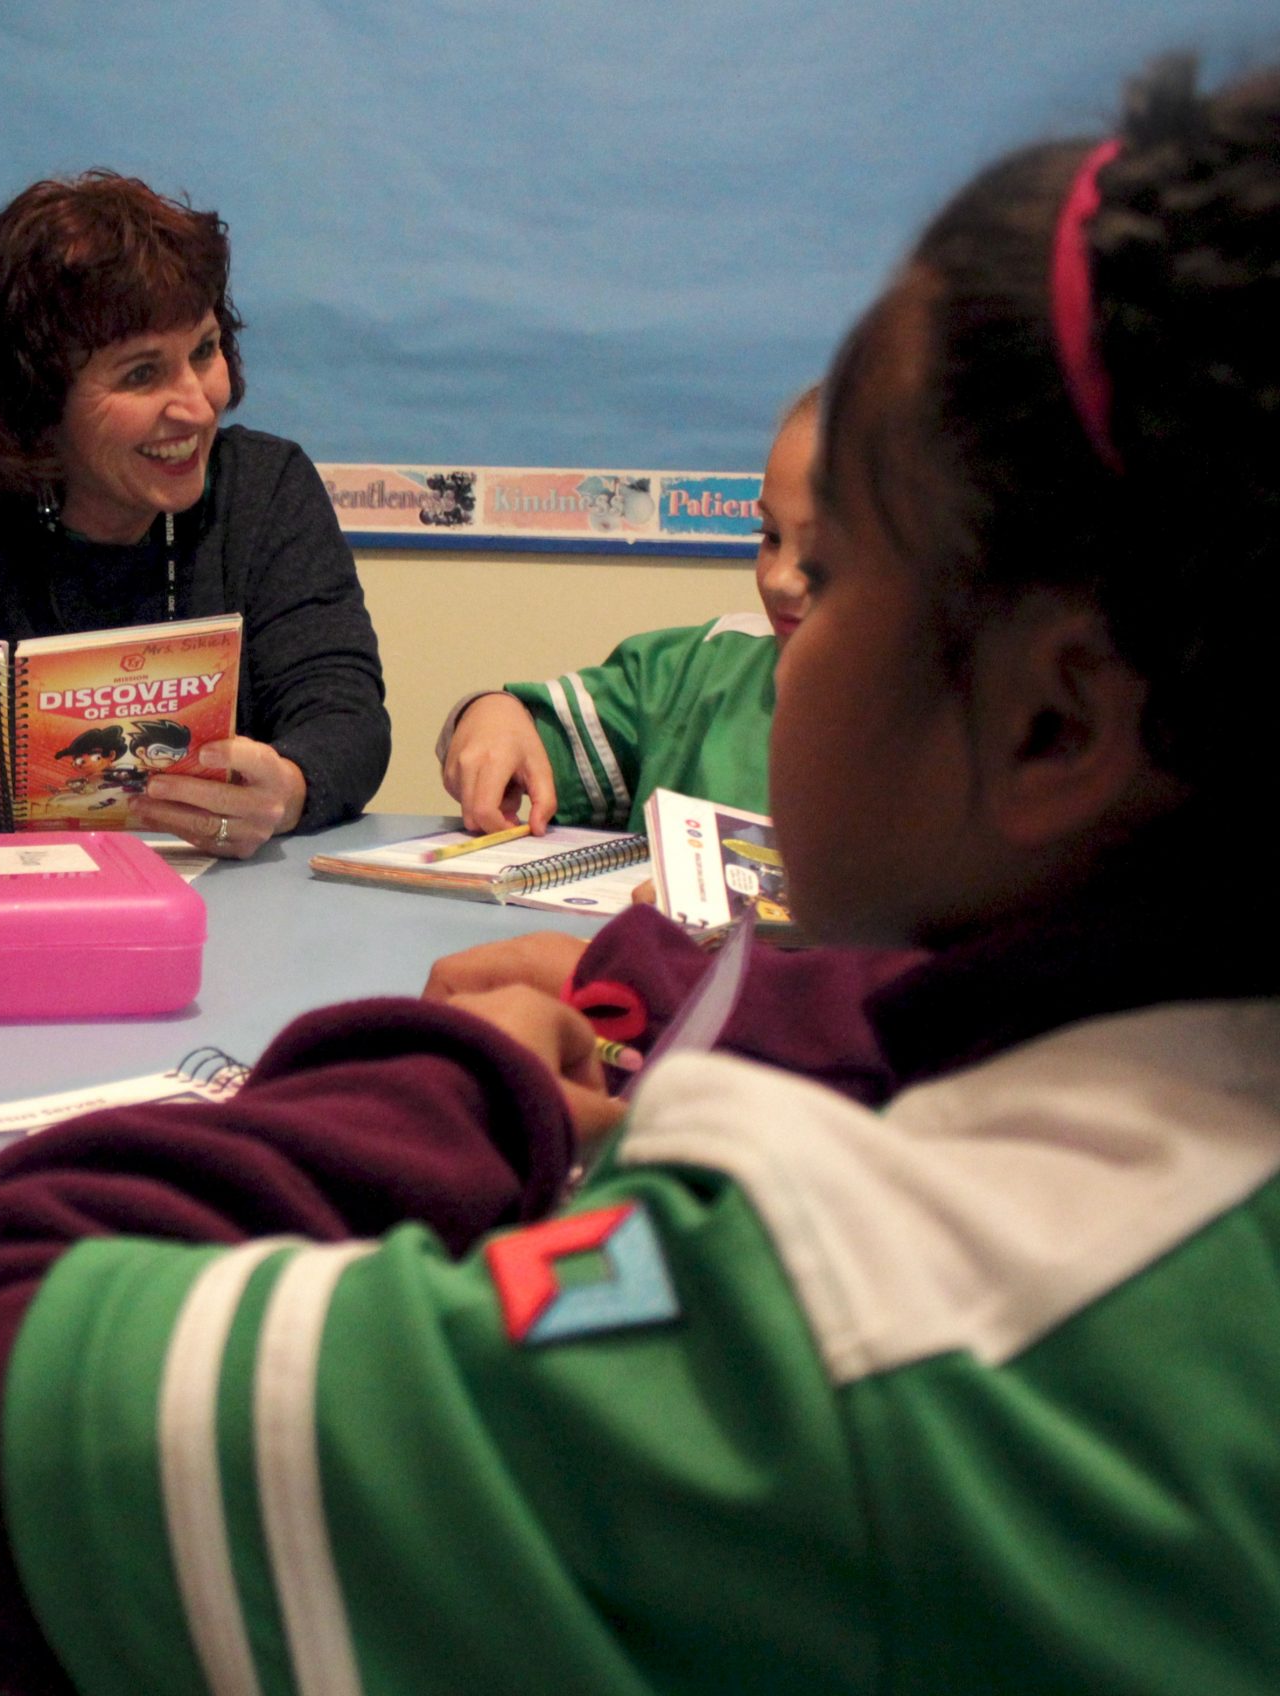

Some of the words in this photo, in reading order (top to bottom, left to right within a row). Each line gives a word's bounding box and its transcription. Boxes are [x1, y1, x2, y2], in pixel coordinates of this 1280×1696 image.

[494, 486, 624, 516] Kindness
[39, 672, 225, 710] DISCOVERY
[113, 674, 149, 683] MISSION
[83, 706, 107, 720] OF
[115, 699, 179, 717] GRACE
